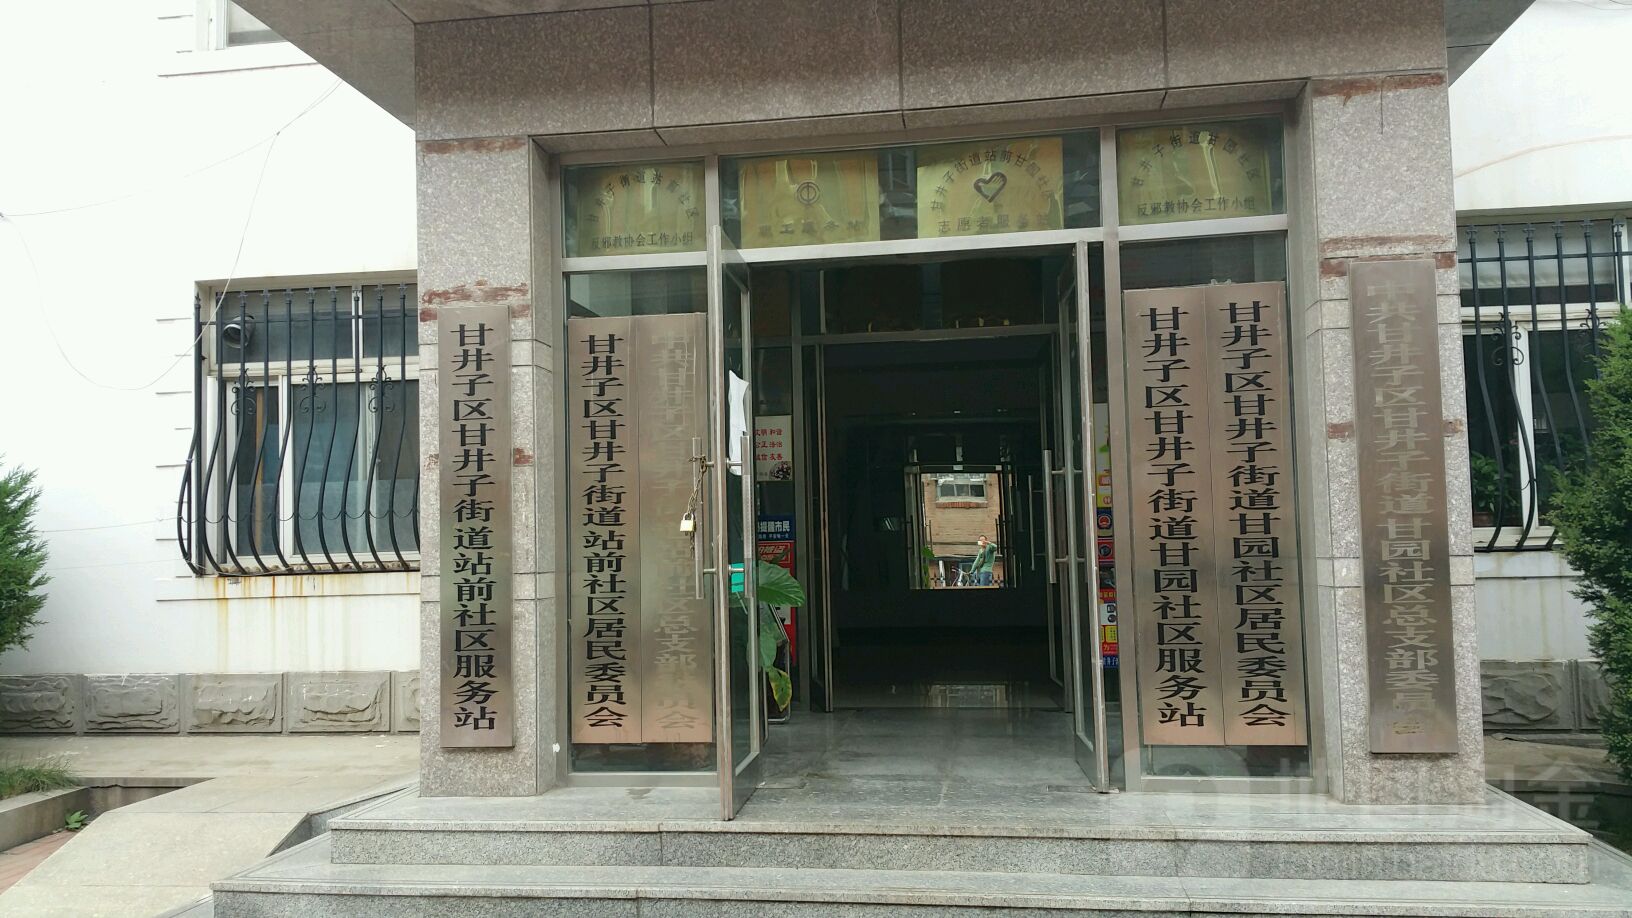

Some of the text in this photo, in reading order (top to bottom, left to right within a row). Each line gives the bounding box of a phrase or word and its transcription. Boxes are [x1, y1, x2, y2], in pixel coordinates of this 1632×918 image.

[1136, 195, 1257, 217] 反邪教协会工作小组
[450, 322, 499, 730] 甘井子区甘井子街道站前社区服务站
[579, 333, 629, 728] 甘井子区甘井子街道站前社区居民委员会
[757, 520, 790, 533] 提醒市民
[1140, 306, 1208, 728] 甘井子区甘井子街道甘园社区服务站
[1218, 300, 1292, 728] 甘井子区甘井子街道甘园社区居民委员会
